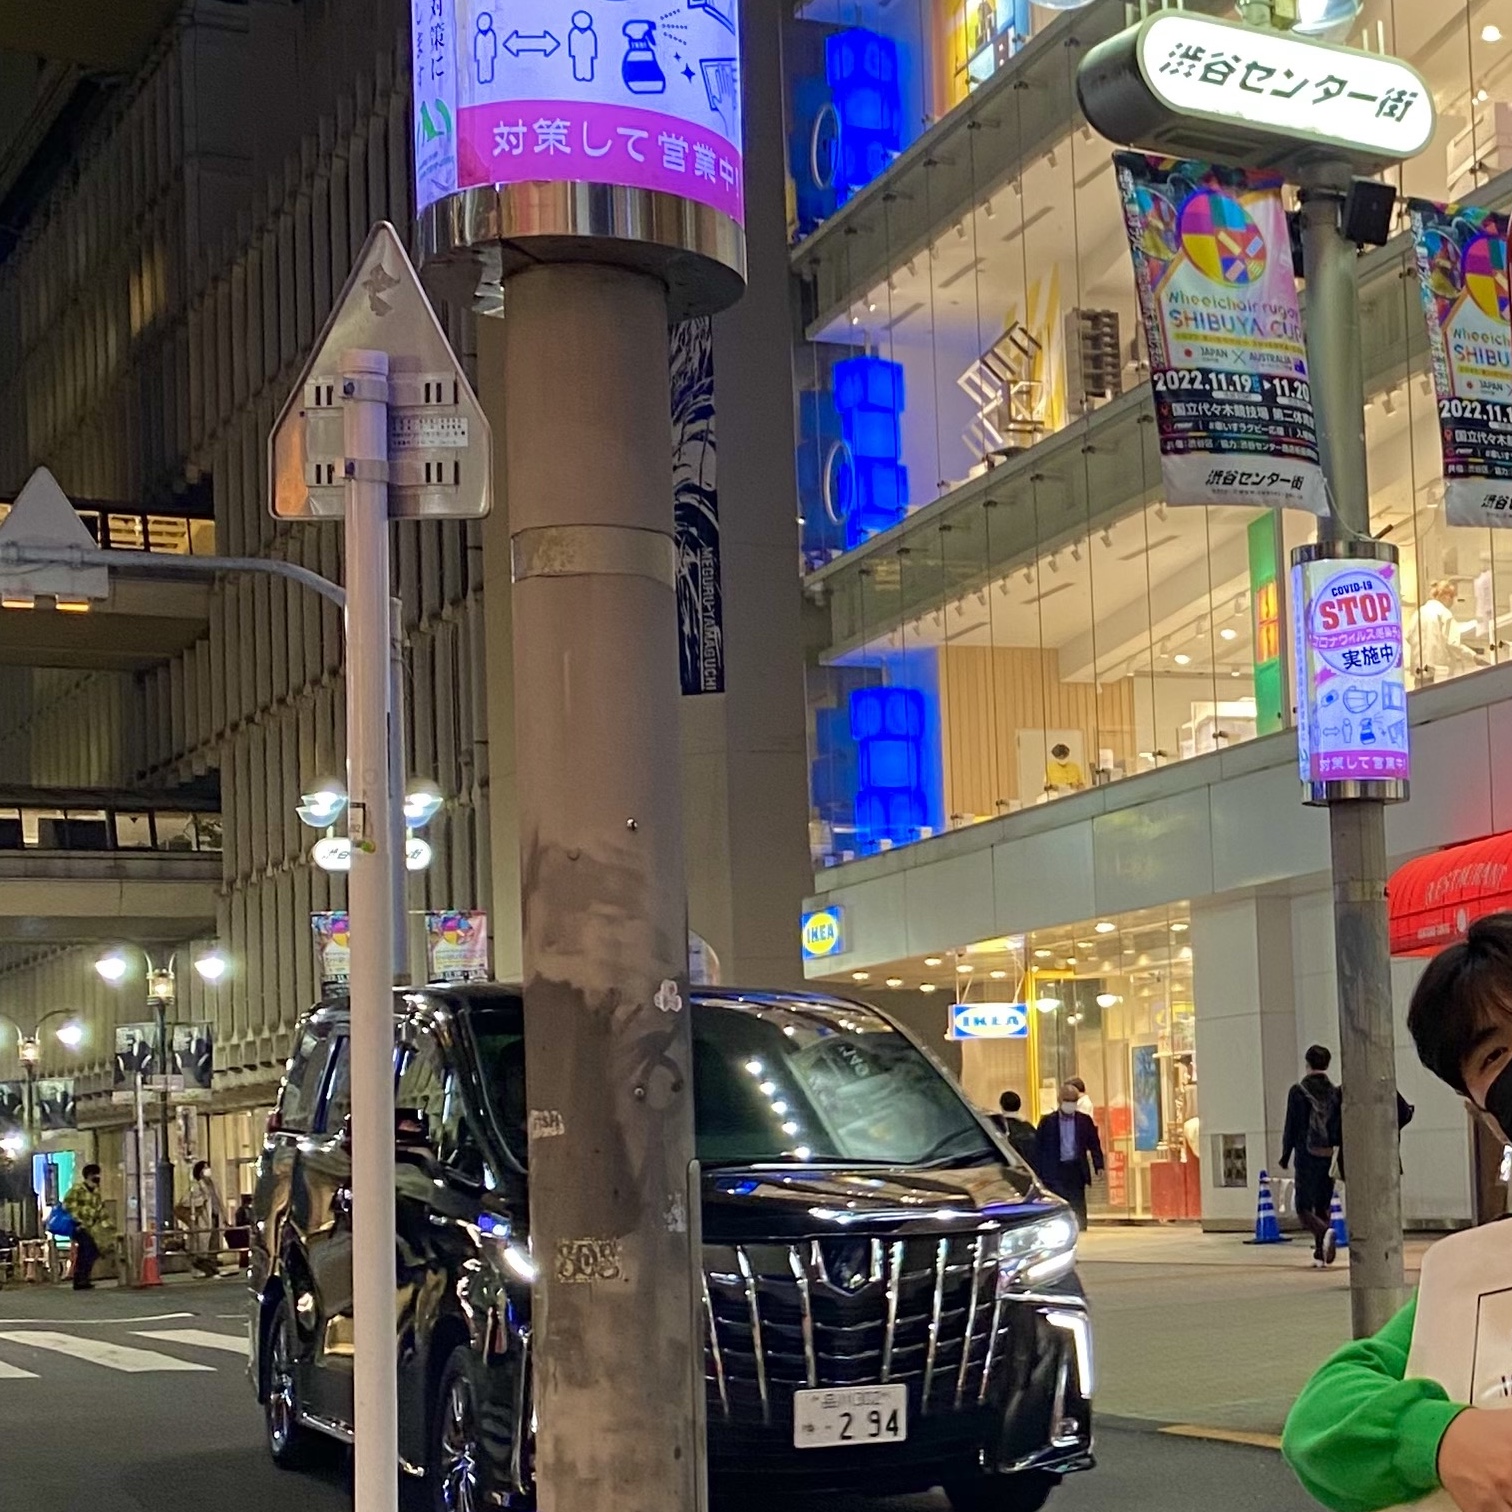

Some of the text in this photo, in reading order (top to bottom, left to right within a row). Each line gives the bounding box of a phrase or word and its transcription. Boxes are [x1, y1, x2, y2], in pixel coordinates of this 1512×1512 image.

[1159, 42, 1418, 122] 渋谷センター街
[1169, 290, 1257, 312] Wheelchair
[1168, 308, 1264, 336] SHIBUYA
[1200, 346, 1228, 358] JAPAN
[1249, 351, 1291, 364] AUSTRALIA
[1453, 343, 1510, 369] SHIBU
[1153, 372, 1251, 392] 2022.11.19
[1205, 469, 1304, 491] 渋谷センター街
[1331, 580, 1373, 597] COVID-19
[1319, 592, 1391, 631] STOP
[1342, 643, 1394, 671] 実施中
[807, 924, 834, 943] IKEA
[963, 1015, 1019, 1027] IKEA
